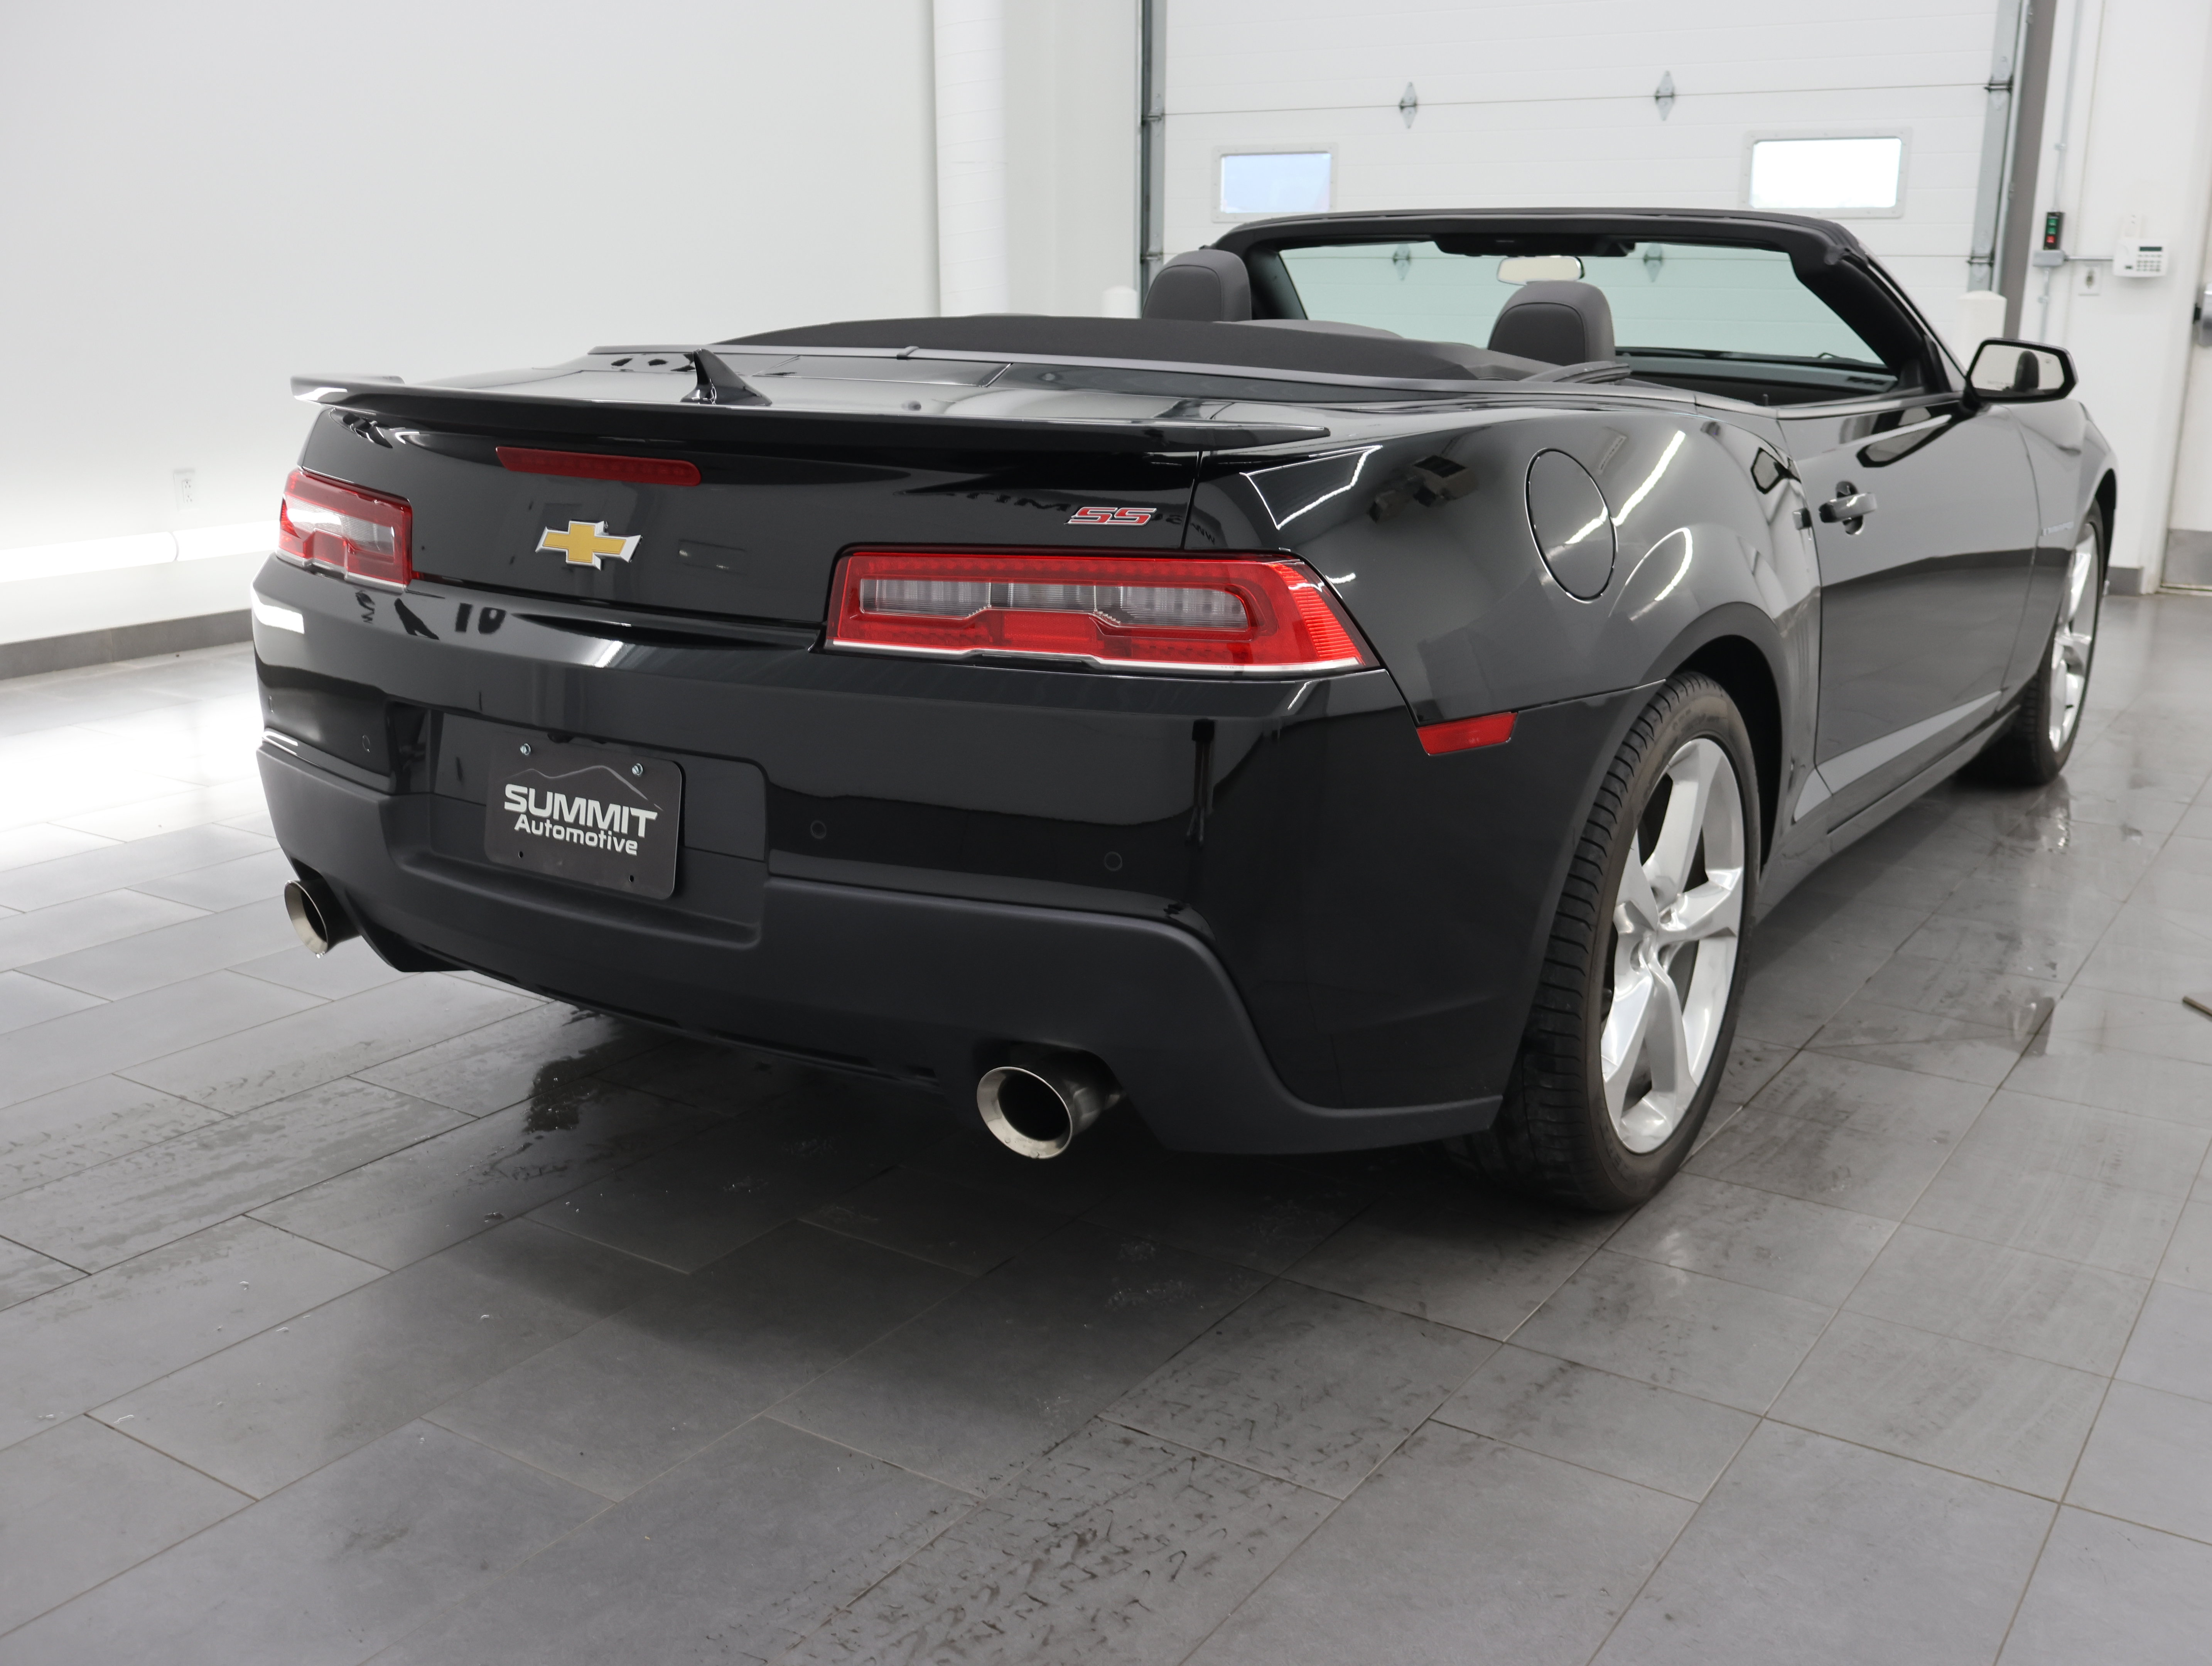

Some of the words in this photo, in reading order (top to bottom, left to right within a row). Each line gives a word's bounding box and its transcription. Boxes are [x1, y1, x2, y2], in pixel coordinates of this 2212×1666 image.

[1067, 506, 1157, 526] SS
[504, 784, 658, 838] SUMMIT
[514, 813, 638, 856] Automotive
